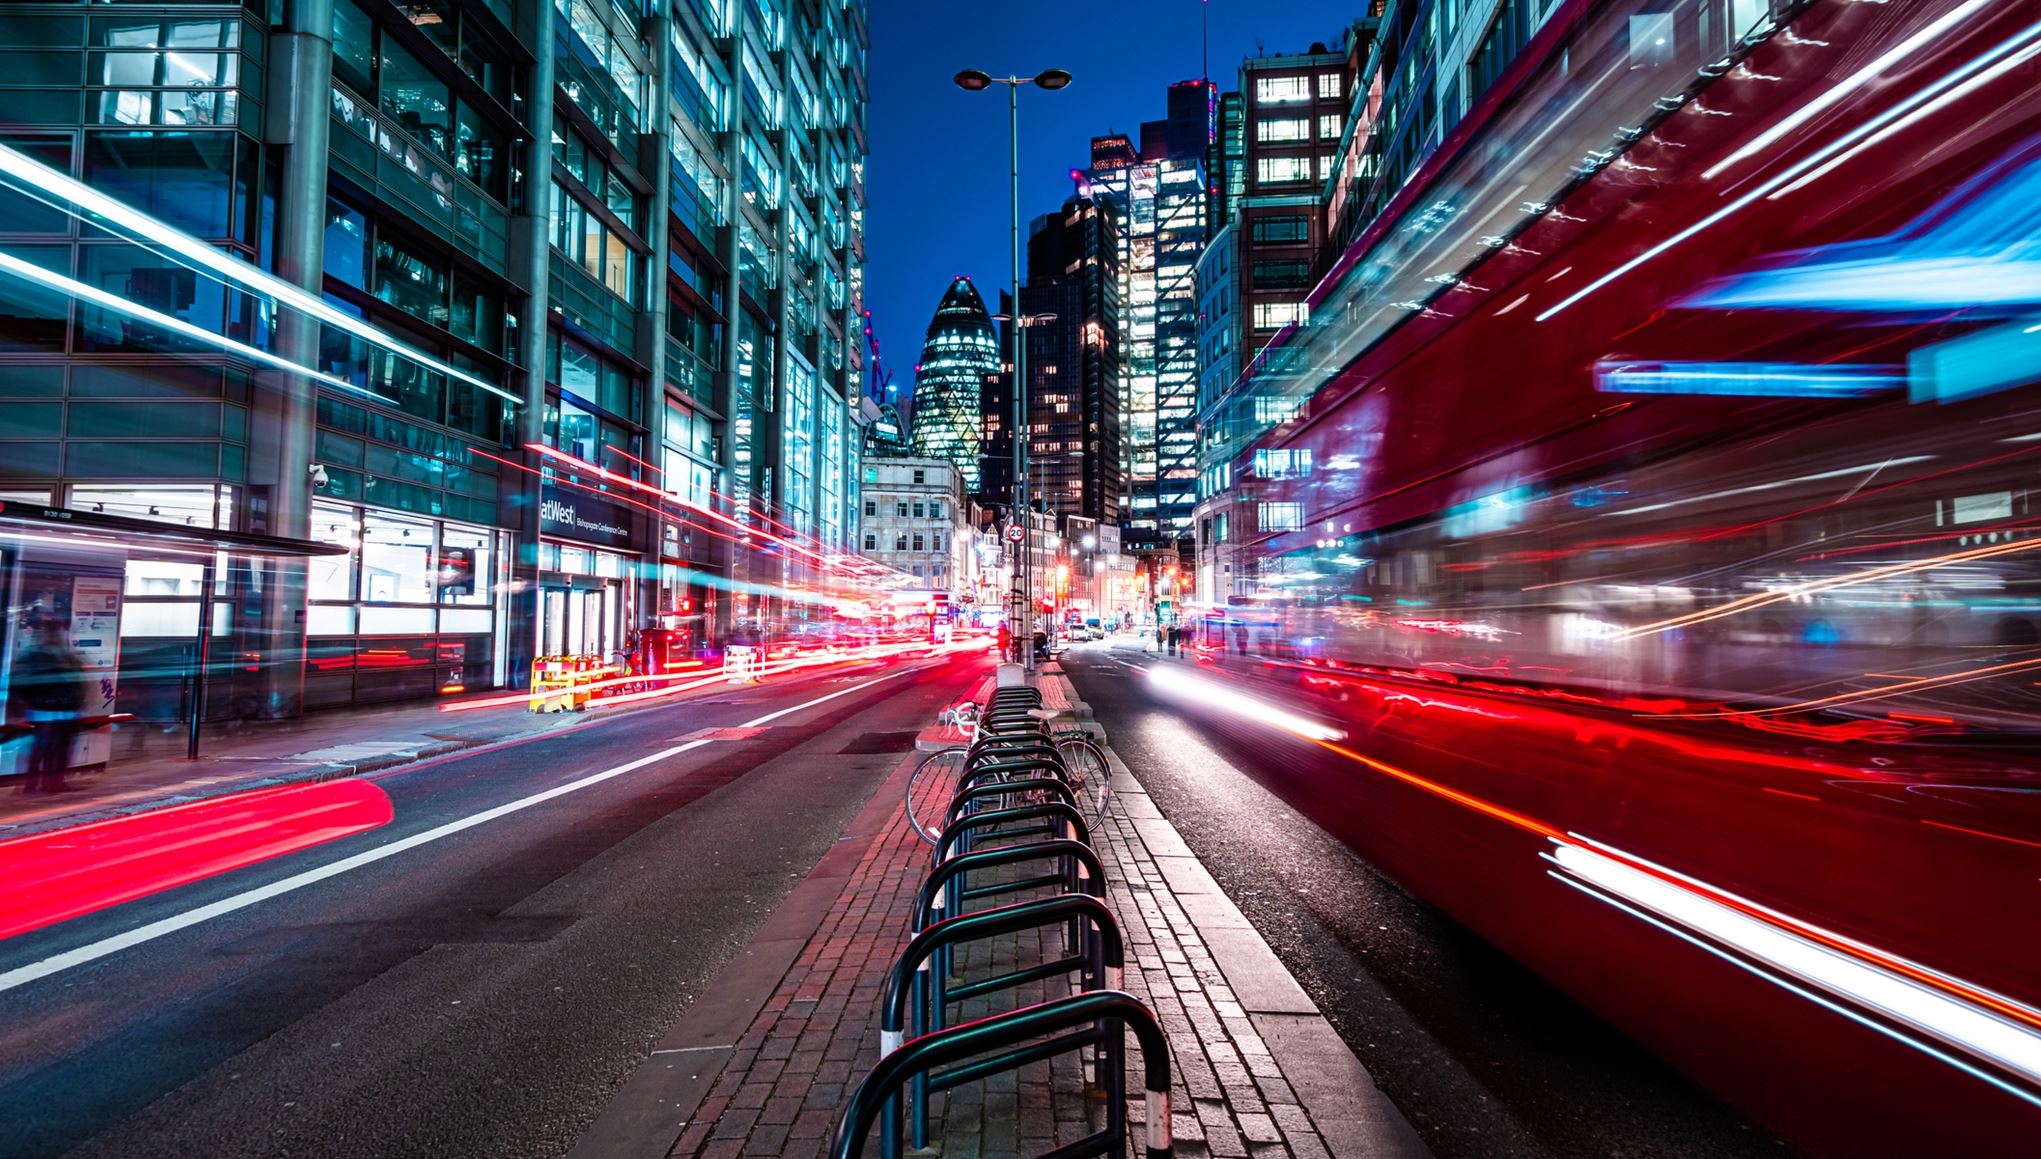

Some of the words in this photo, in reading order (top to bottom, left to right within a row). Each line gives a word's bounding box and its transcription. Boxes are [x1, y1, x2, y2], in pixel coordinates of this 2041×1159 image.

[541, 499, 574, 525] atWest
[576, 517, 598, 531] Bishopsgate
[598, 522, 617, 534] Conference
[617, 526, 628, 537] Centre
[1010, 529, 1022, 537] 20
